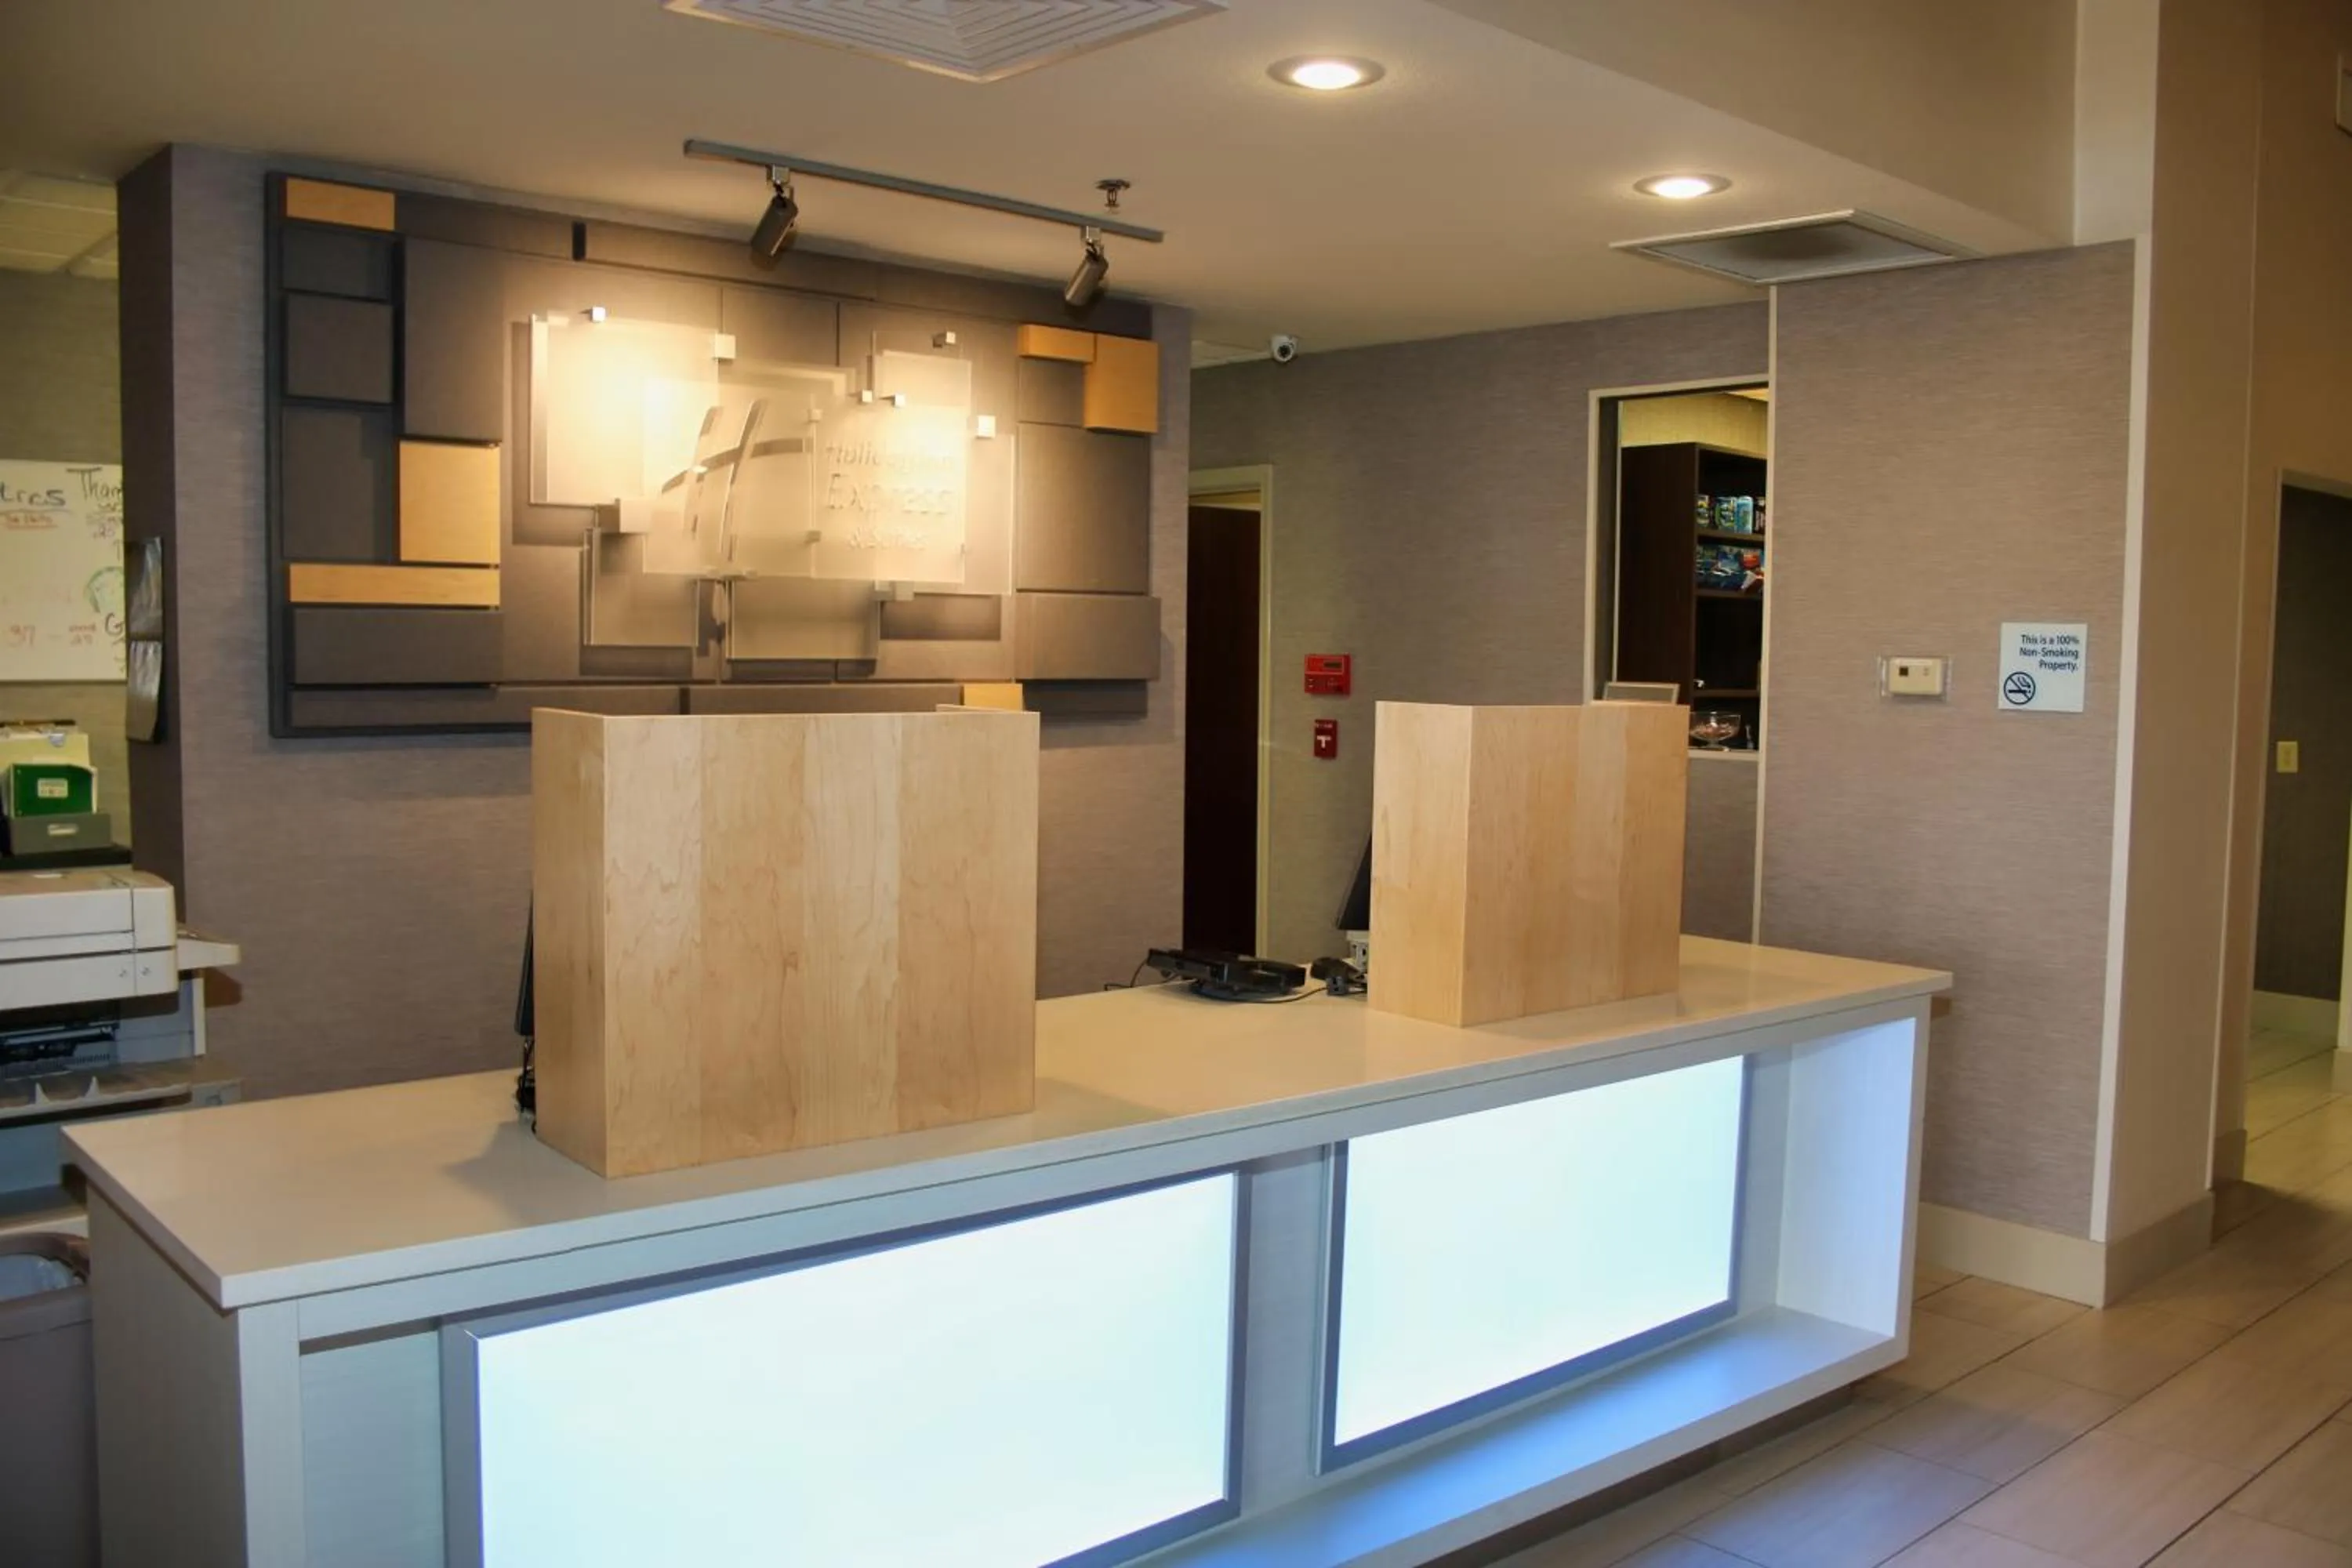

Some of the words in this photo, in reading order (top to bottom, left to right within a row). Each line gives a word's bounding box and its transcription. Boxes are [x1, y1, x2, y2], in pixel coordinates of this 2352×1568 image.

[2020, 634, 2038, 644] This
[2040, 634, 2046, 644] is
[2020, 647, 2078, 659] Non-Smoking
